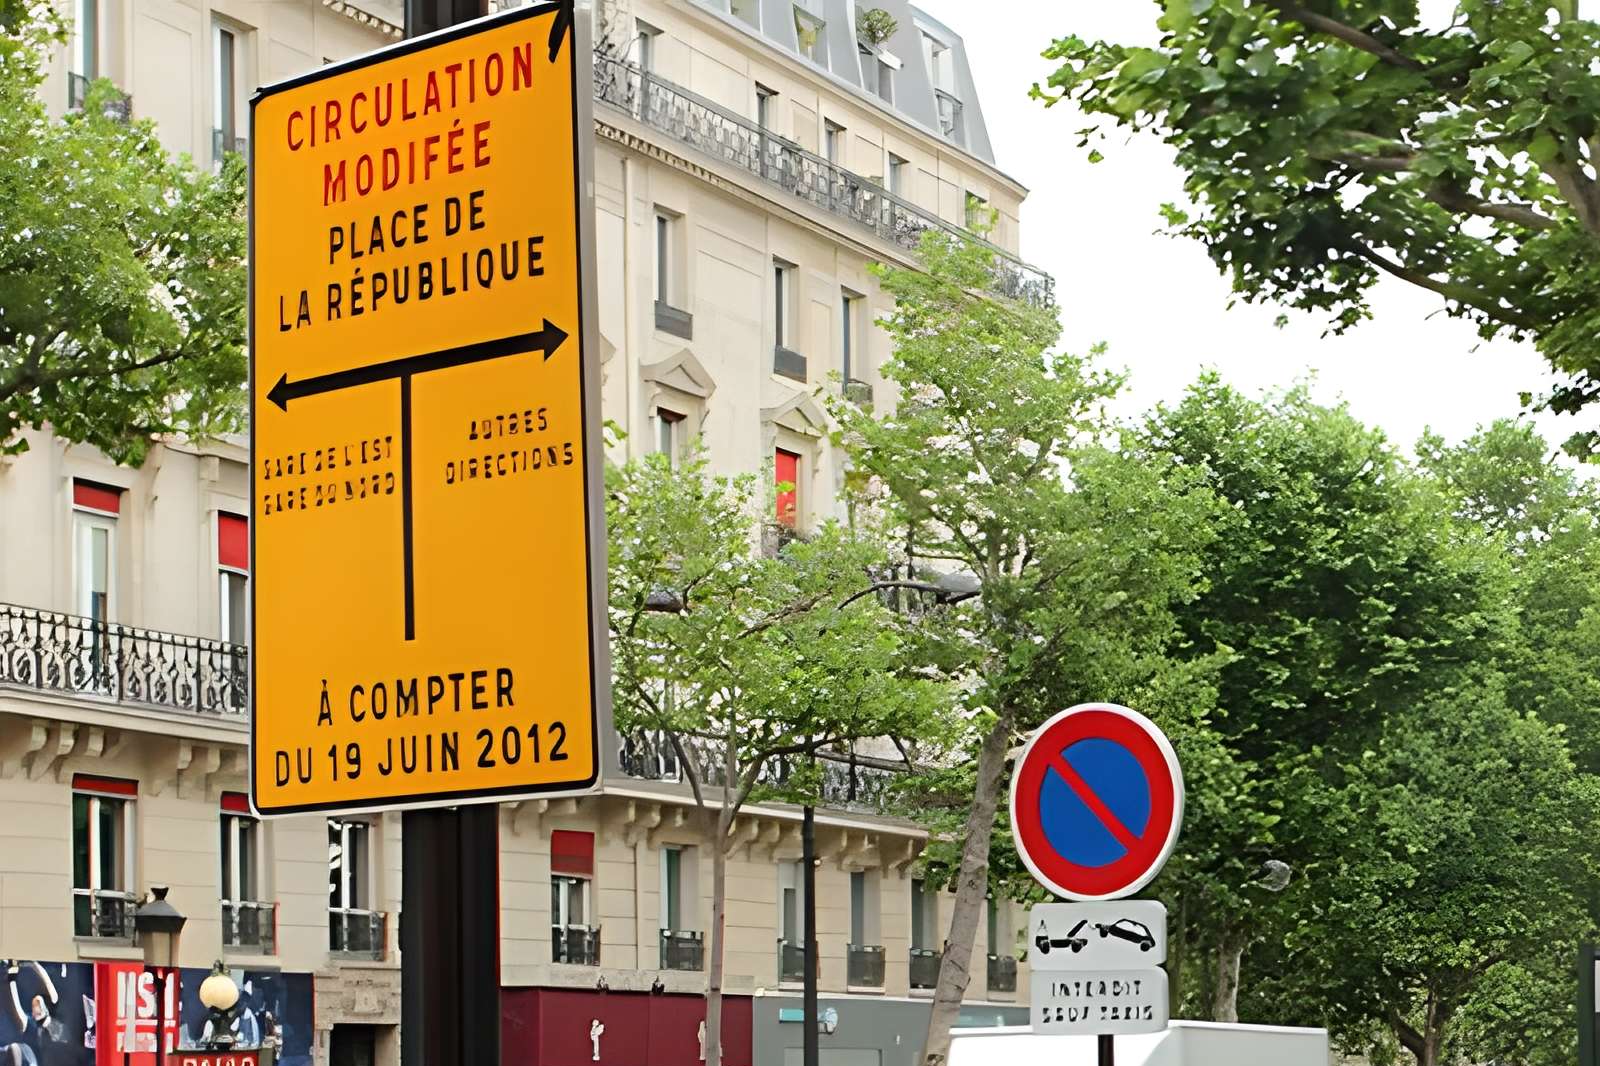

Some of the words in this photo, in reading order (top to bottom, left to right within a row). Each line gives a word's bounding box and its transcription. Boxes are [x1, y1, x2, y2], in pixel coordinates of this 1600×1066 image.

[288, 42, 532, 151] CIRCULATION
[323, 118, 491, 206] MODIFÉE
[329, 204, 428, 265] PLACE
[445, 190, 486, 236] DE
[279, 290, 311, 332] LA
[327, 236, 545, 321] RÉPUBLIQUE
[446, 442, 573, 484] DIRECTIONS
[317, 680, 333, 726] À
[350, 668, 515, 723] COMPTER
[275, 747, 312, 787] DU
[328, 742, 361, 782] 19
[378, 731, 459, 776] JUIN
[476, 721, 569, 768] 2012
